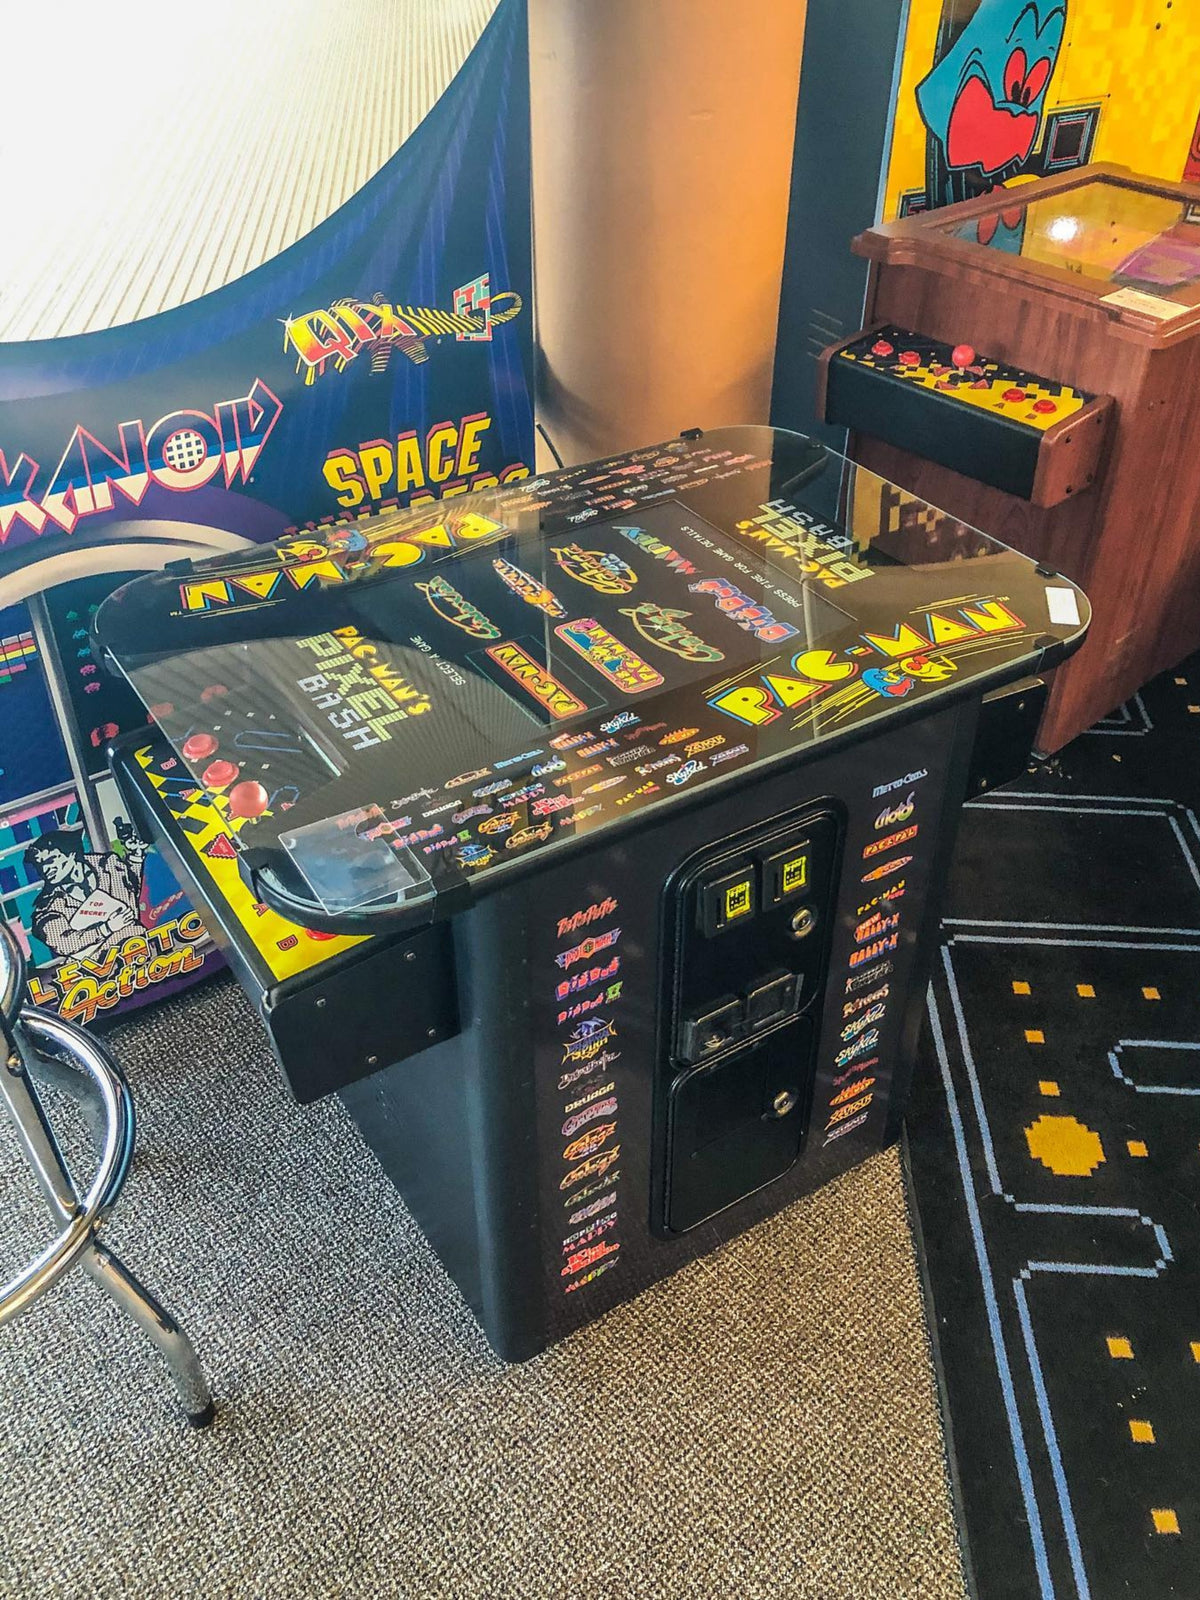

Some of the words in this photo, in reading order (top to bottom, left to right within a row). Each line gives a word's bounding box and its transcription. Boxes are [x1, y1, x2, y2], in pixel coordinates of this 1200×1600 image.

[322, 411, 492, 508] SPACE
[680, 526, 714, 548] DETAILS
[766, 498, 855, 550] BASH
[179, 512, 509, 611] PAC-MAN
[713, 546, 732, 563] GAME
[736, 520, 849, 589] PAC-MAN'S
[750, 503, 876, 583] PIXEL
[733, 562, 750, 576] FOR
[750, 573, 771, 591] FIRE
[774, 587, 802, 608] PRESS
[409, 635, 432, 654] GAME
[707, 600, 1027, 726] PAC-MAN
[296, 632, 409, 741] PIXEL
[332, 626, 432, 716] PAC-MAN'S
[436, 662, 466, 686] SELECT
[491, 644, 580, 714] PAC-MAN
[297, 673, 381, 750] BASH
[857, 879, 906, 916] PAC-MAN
[276, 934, 299, 952] B
[855, 912, 900, 944] RALLY-X
[849, 932, 898, 968] RALLY-X
[58, 946, 206, 1025] Action
[565, 1081, 615, 1113] DRUAGA
